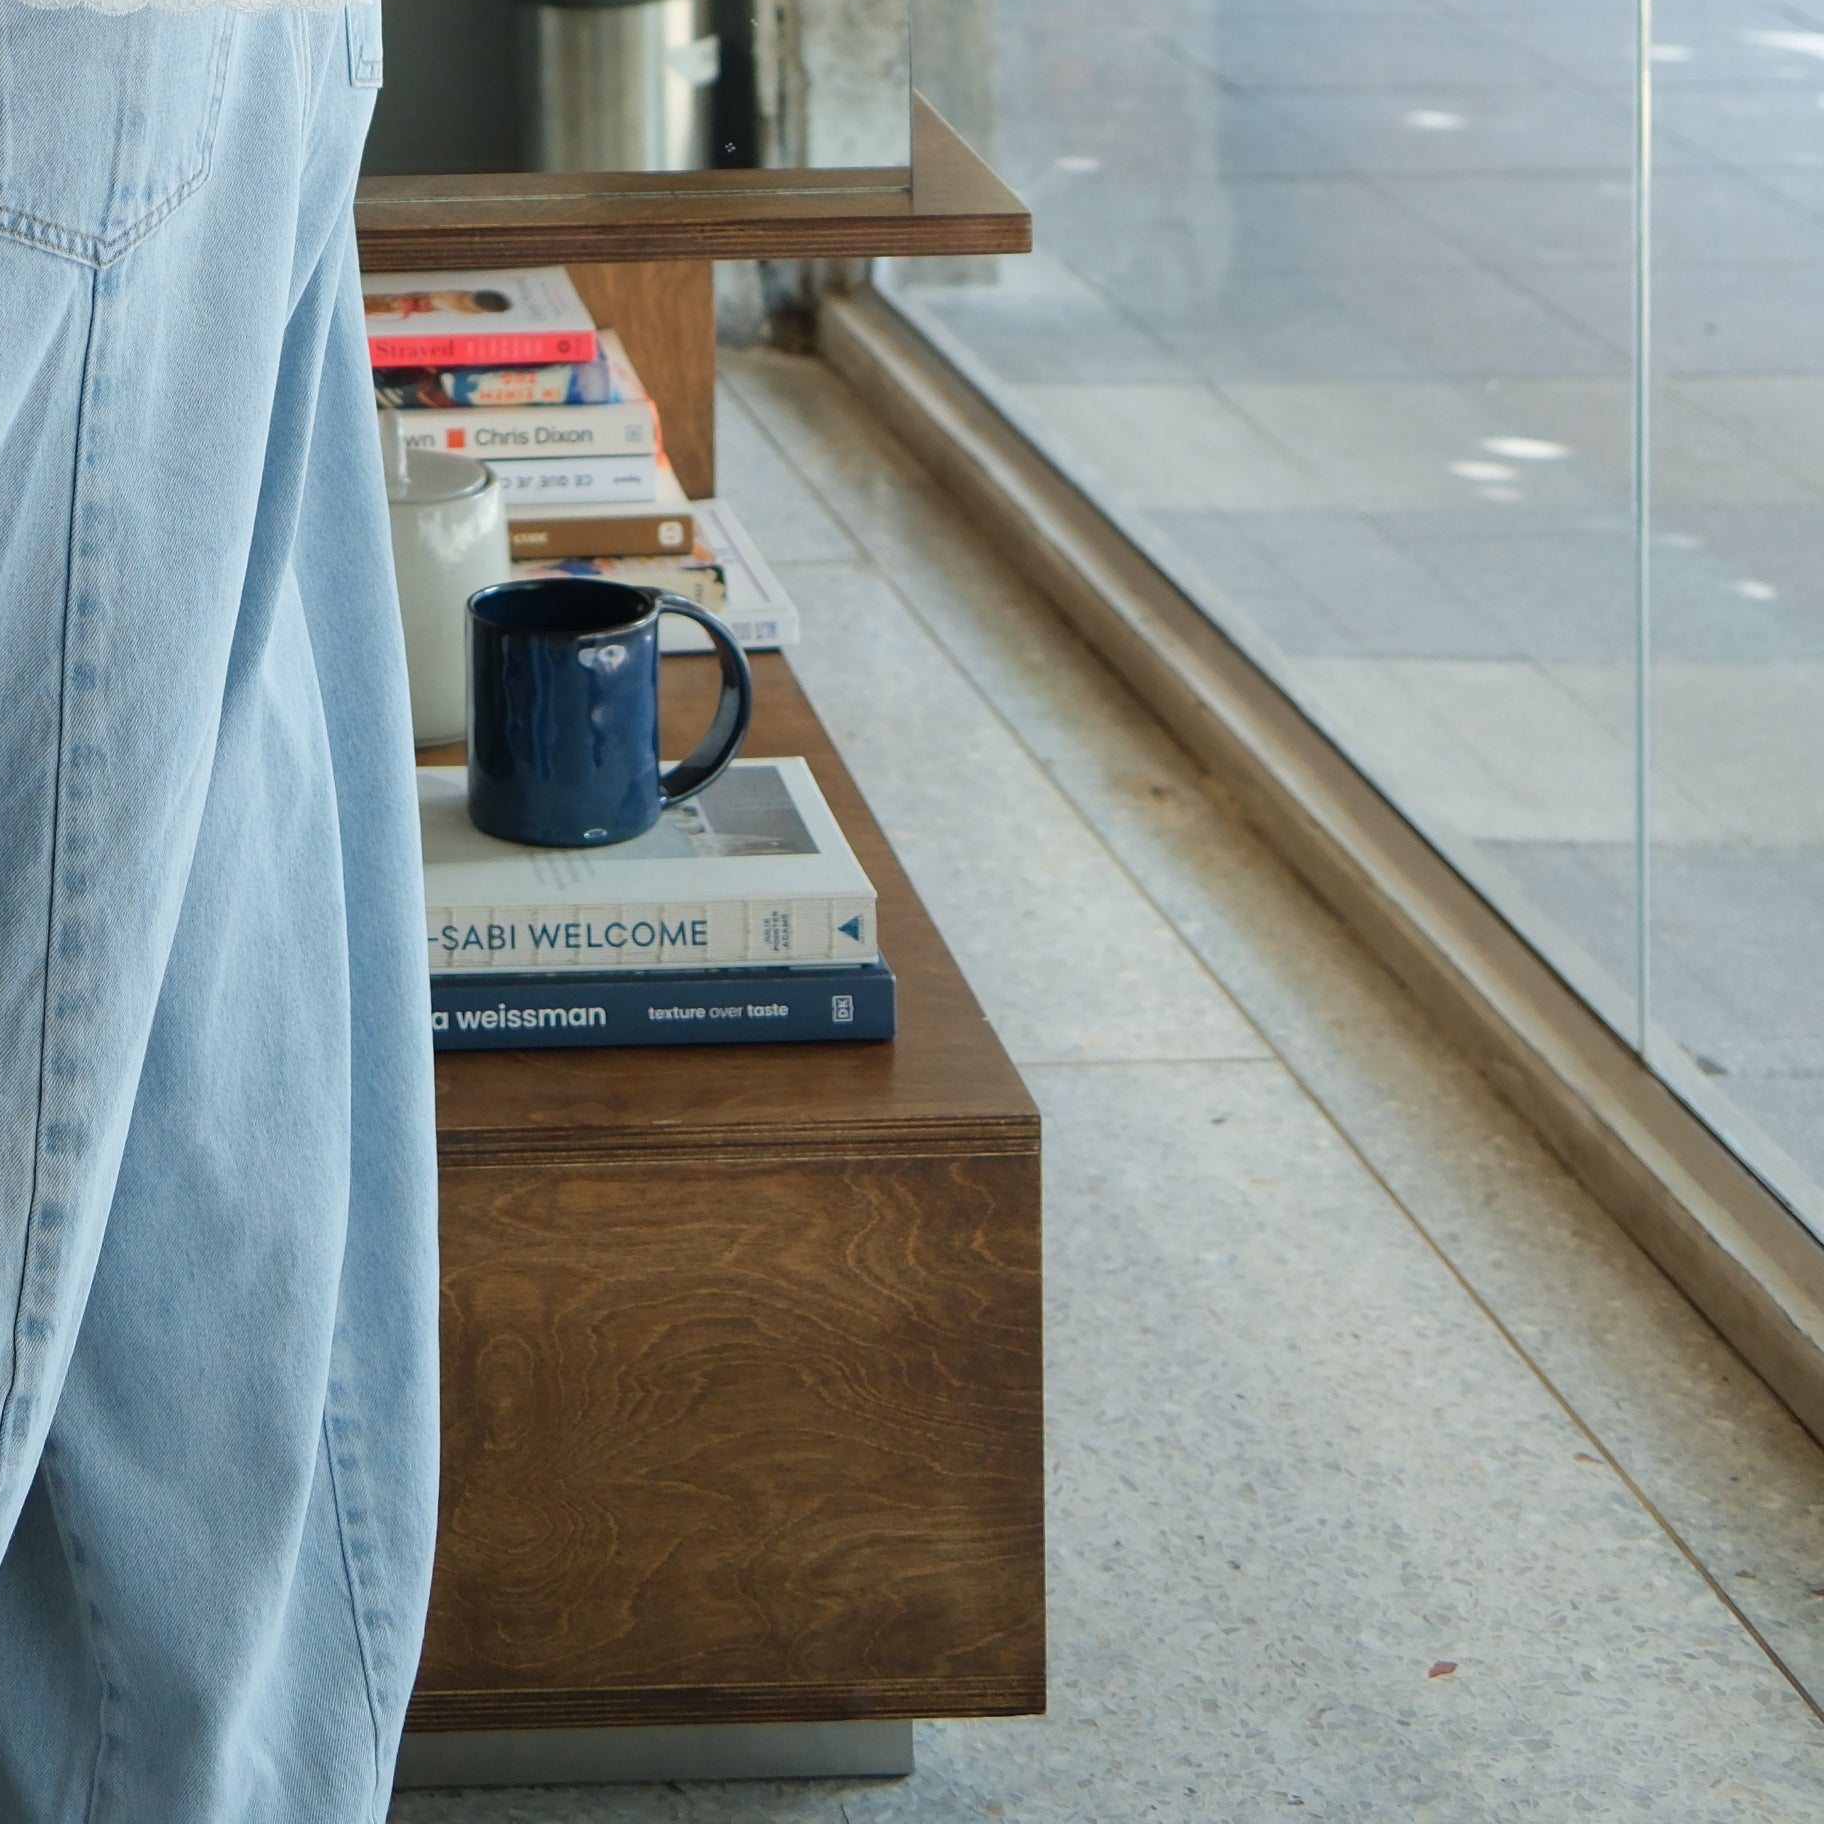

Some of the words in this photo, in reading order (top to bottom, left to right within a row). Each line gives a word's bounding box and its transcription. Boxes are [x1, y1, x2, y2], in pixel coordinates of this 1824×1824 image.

[475, 427, 530, 446] Chris
[535, 425, 594, 444] Dixon
[528, 919, 707, 950] WELCOME
[456, 1002, 607, 1031] weissman
[649, 1007, 706, 1022] texture
[709, 1007, 743, 1020] over
[747, 1002, 790, 1019] taste
